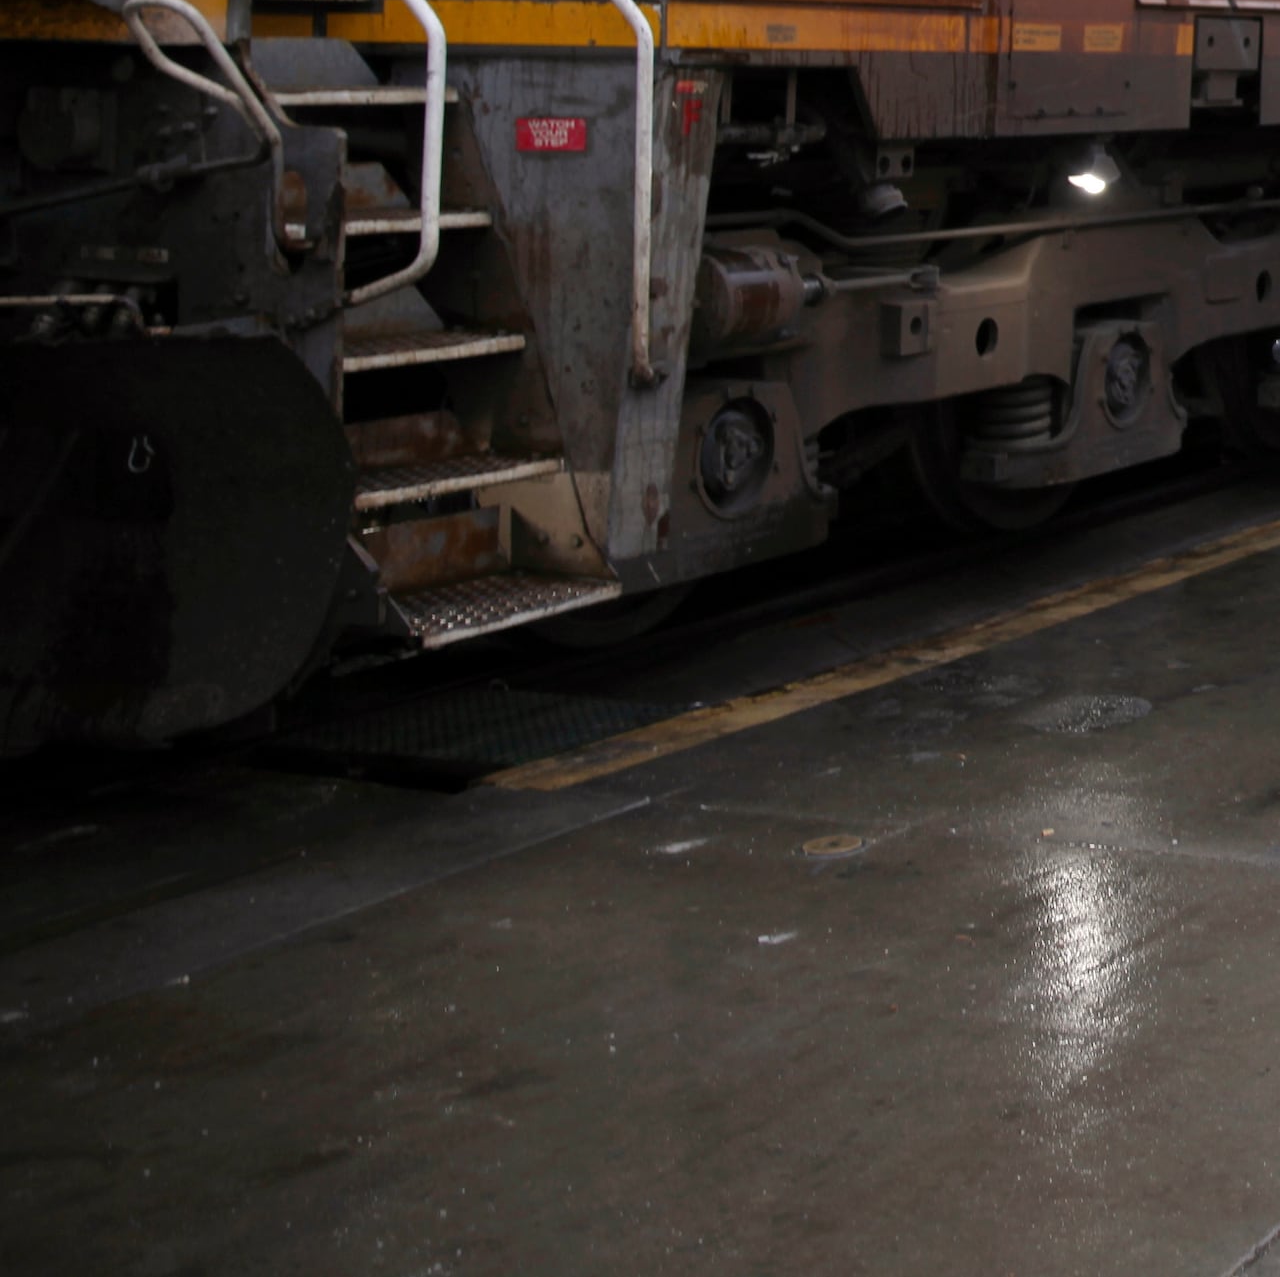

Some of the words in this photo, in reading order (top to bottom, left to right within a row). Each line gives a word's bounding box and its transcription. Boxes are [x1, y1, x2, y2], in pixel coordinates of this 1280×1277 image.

[527, 119, 575, 129] WATCH
[530, 128, 568, 139] YOUR
[534, 137, 568, 147] STEP
